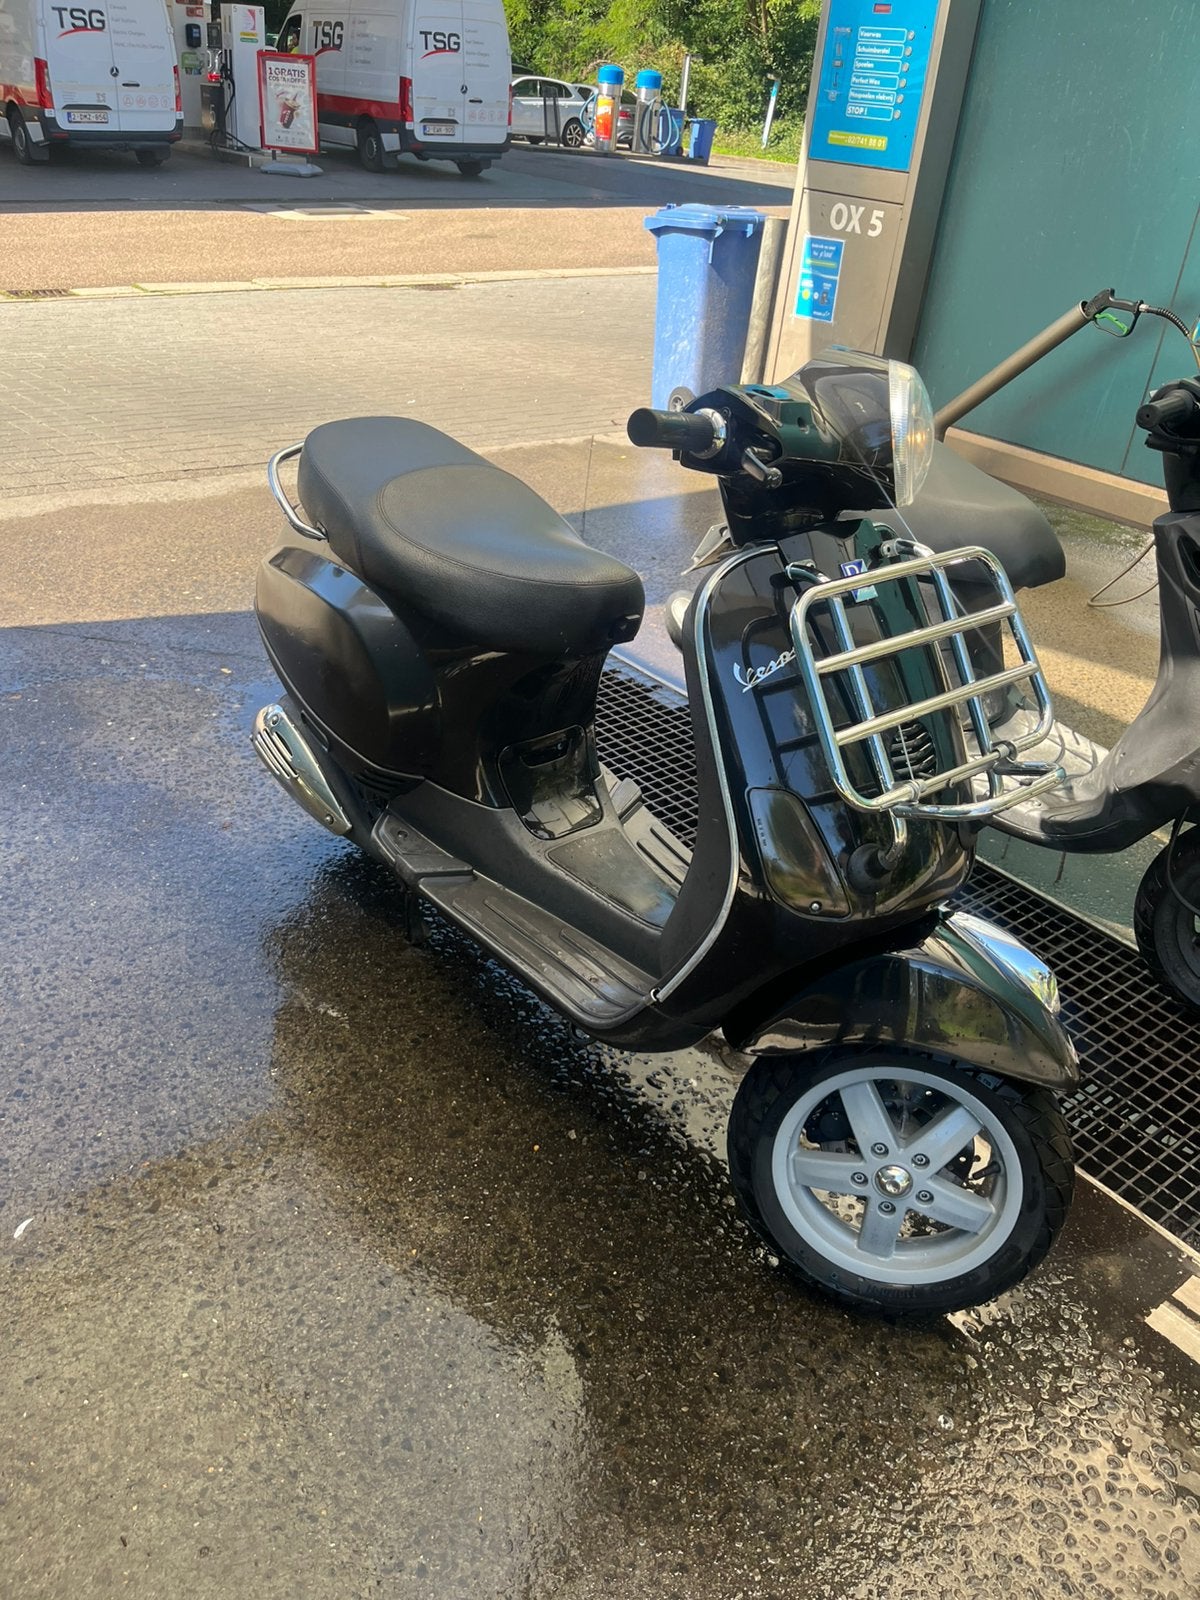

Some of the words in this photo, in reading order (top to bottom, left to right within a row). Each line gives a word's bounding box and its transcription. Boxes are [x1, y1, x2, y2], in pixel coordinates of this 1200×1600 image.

[51, 7, 106, 31] TSG
[313, 21, 344, 49] TSG
[419, 30, 461, 51] TSG
[268, 67, 273, 75] 1
[274, 68, 306, 78] GRATIS
[830, 202, 866, 234] OX
[867, 209, 885, 237] 5
[733, 645, 808, 693] Vesp
